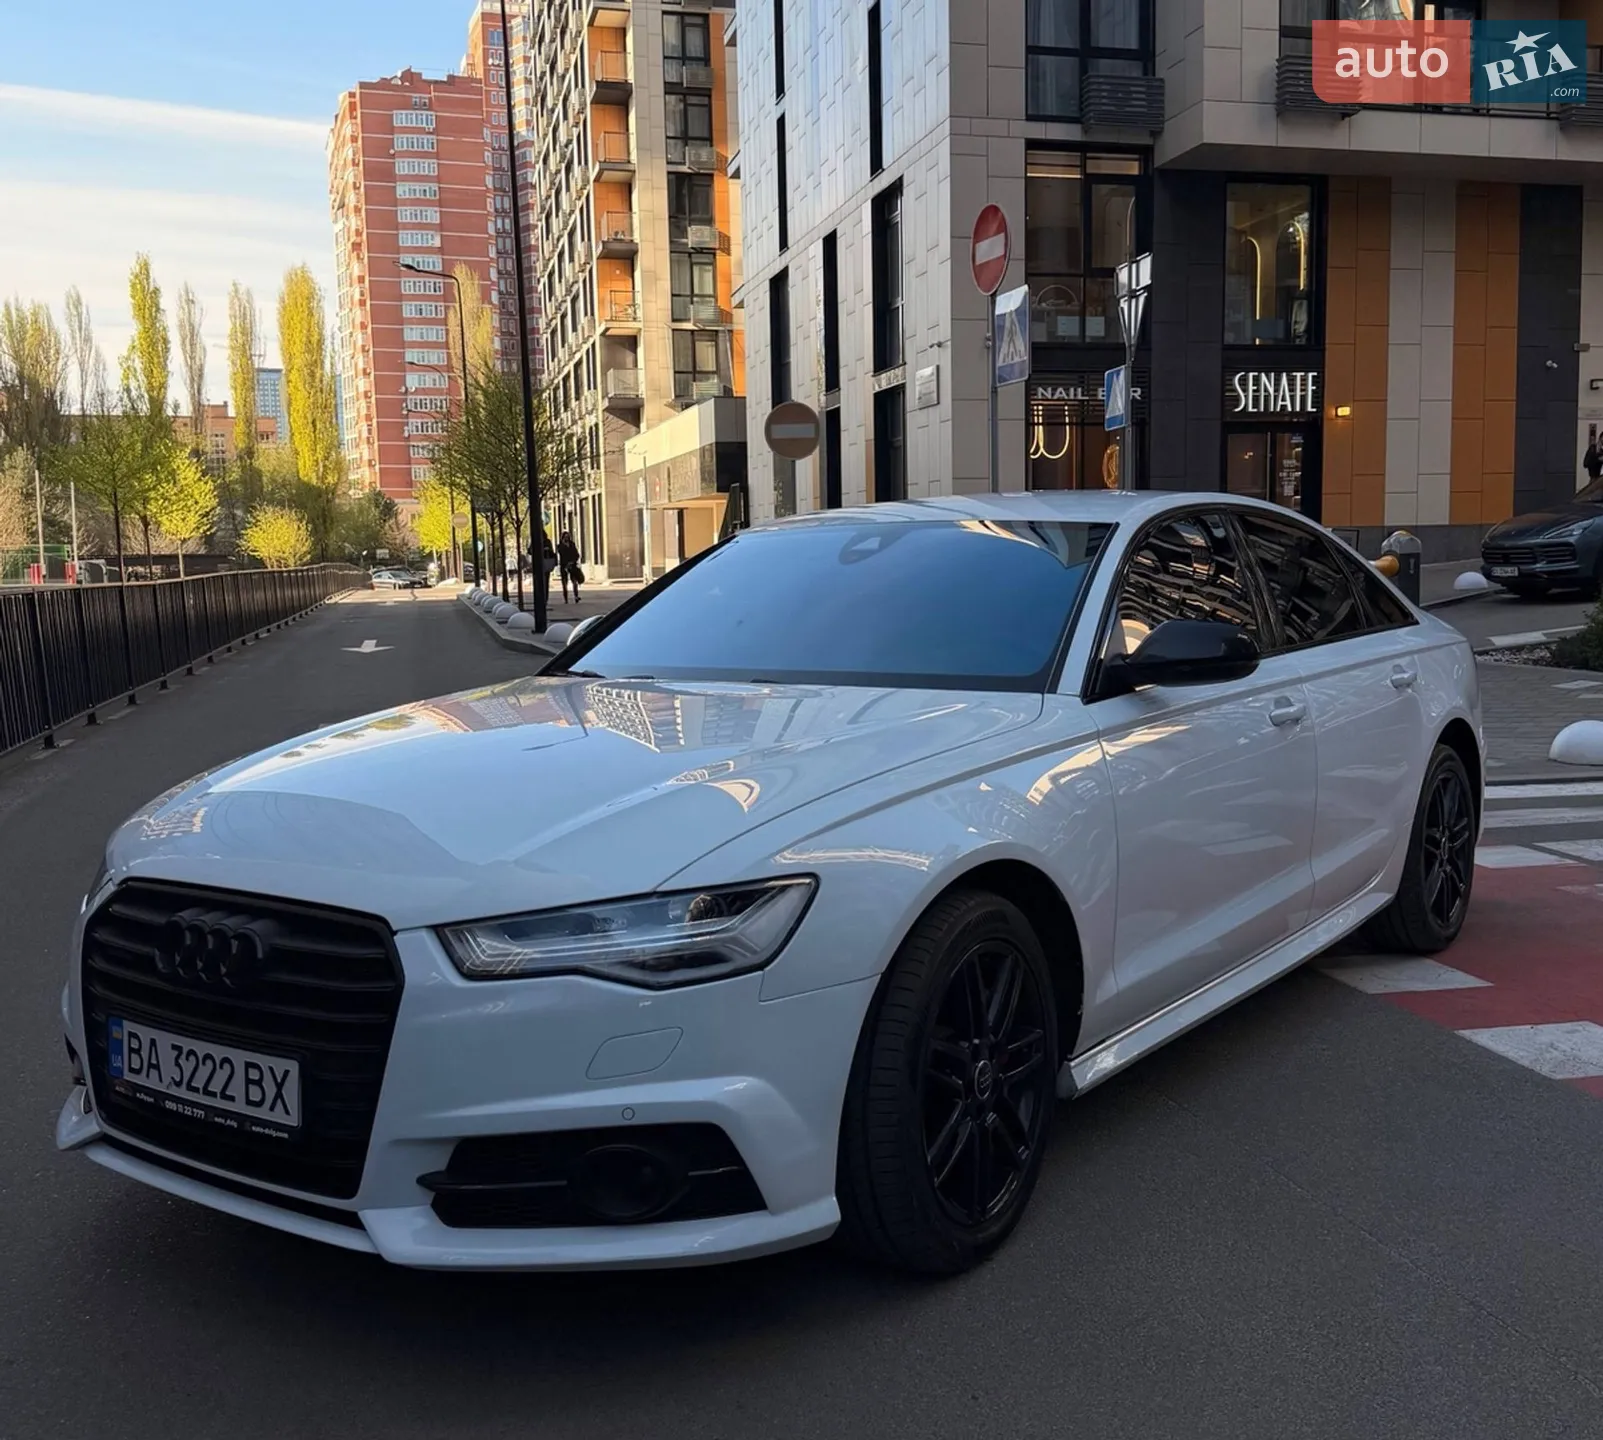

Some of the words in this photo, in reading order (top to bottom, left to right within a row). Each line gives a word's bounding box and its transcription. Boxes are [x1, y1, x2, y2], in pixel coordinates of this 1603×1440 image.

[1036, 386, 1089, 400] NAIL
[1233, 371, 1318, 412] SENATE
[111, 1053, 123, 1068] UA
[127, 1030, 163, 1083] BA
[170, 1043, 237, 1102] 3222
[243, 1060, 292, 1116] BX
